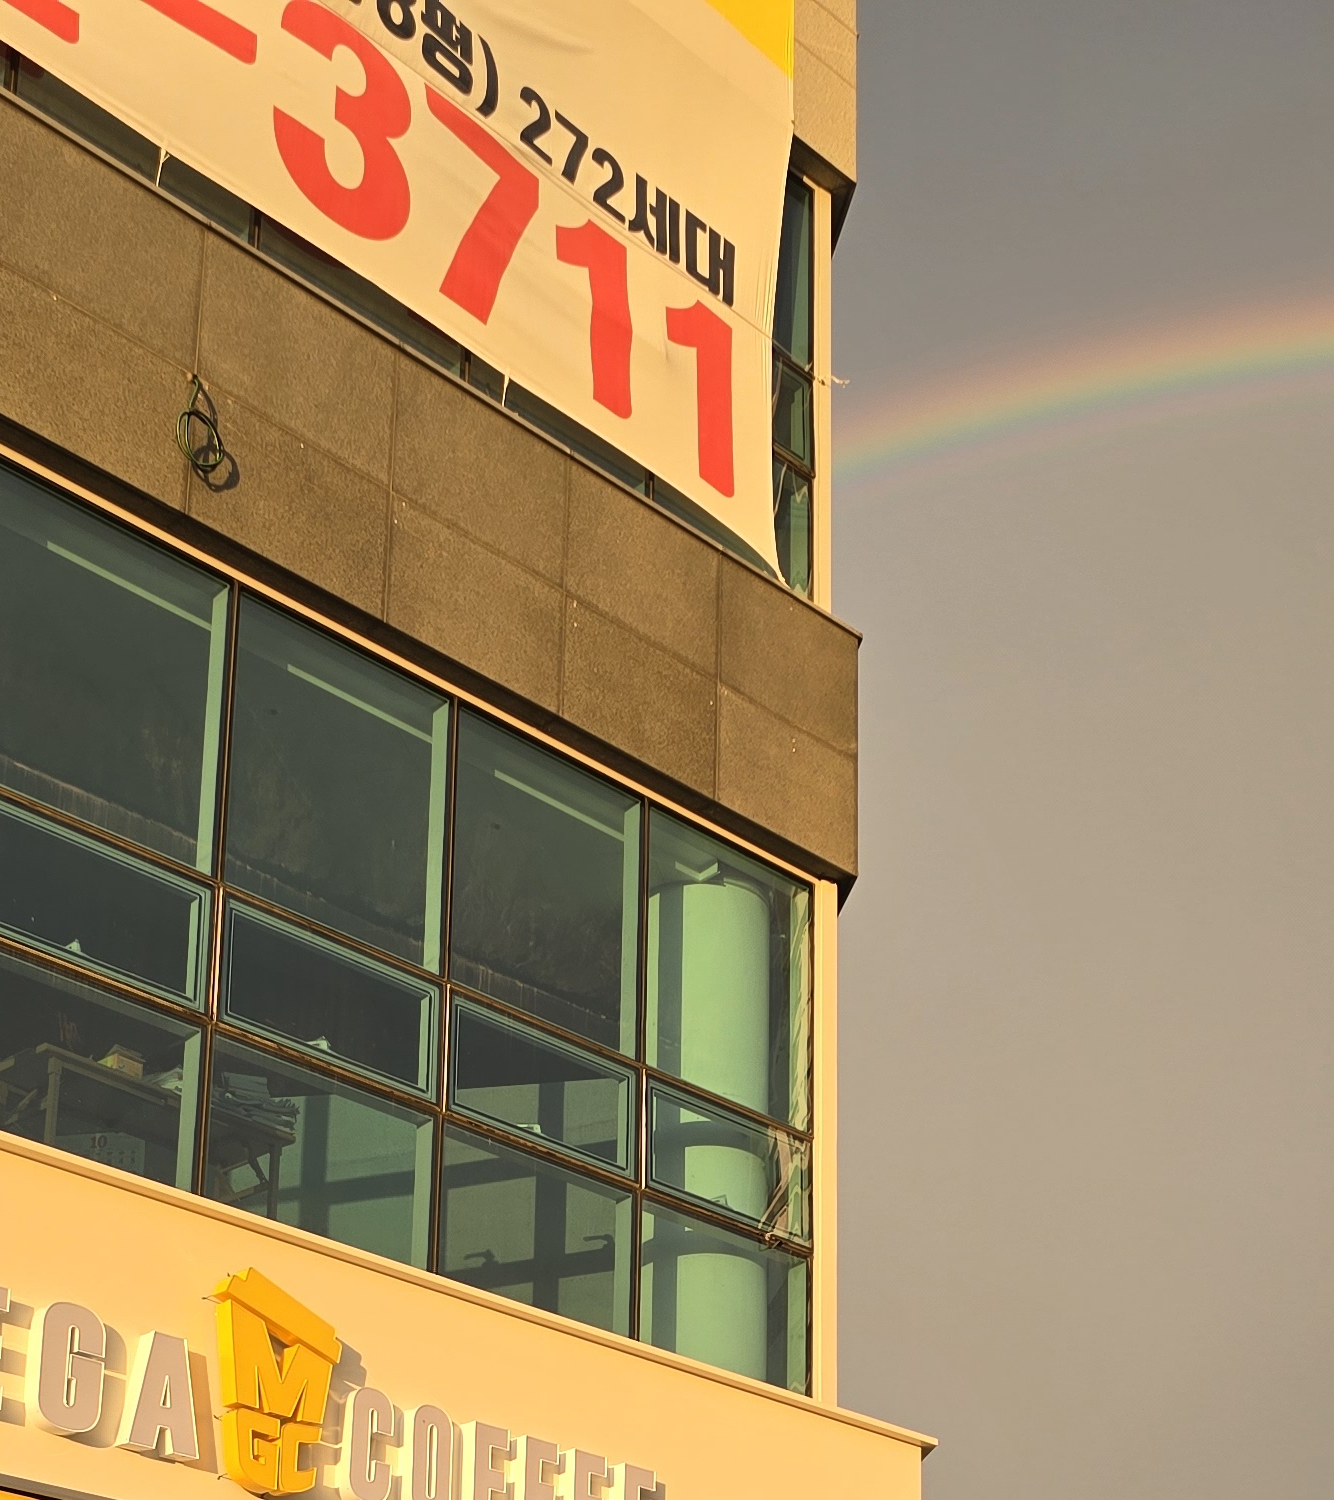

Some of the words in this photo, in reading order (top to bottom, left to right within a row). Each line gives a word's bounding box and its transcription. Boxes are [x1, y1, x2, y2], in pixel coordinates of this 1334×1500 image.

[2, 0, 736, 499] -3711
[519, 86, 736, 308] 272세대
[90, 1135, 108, 1149] 10
